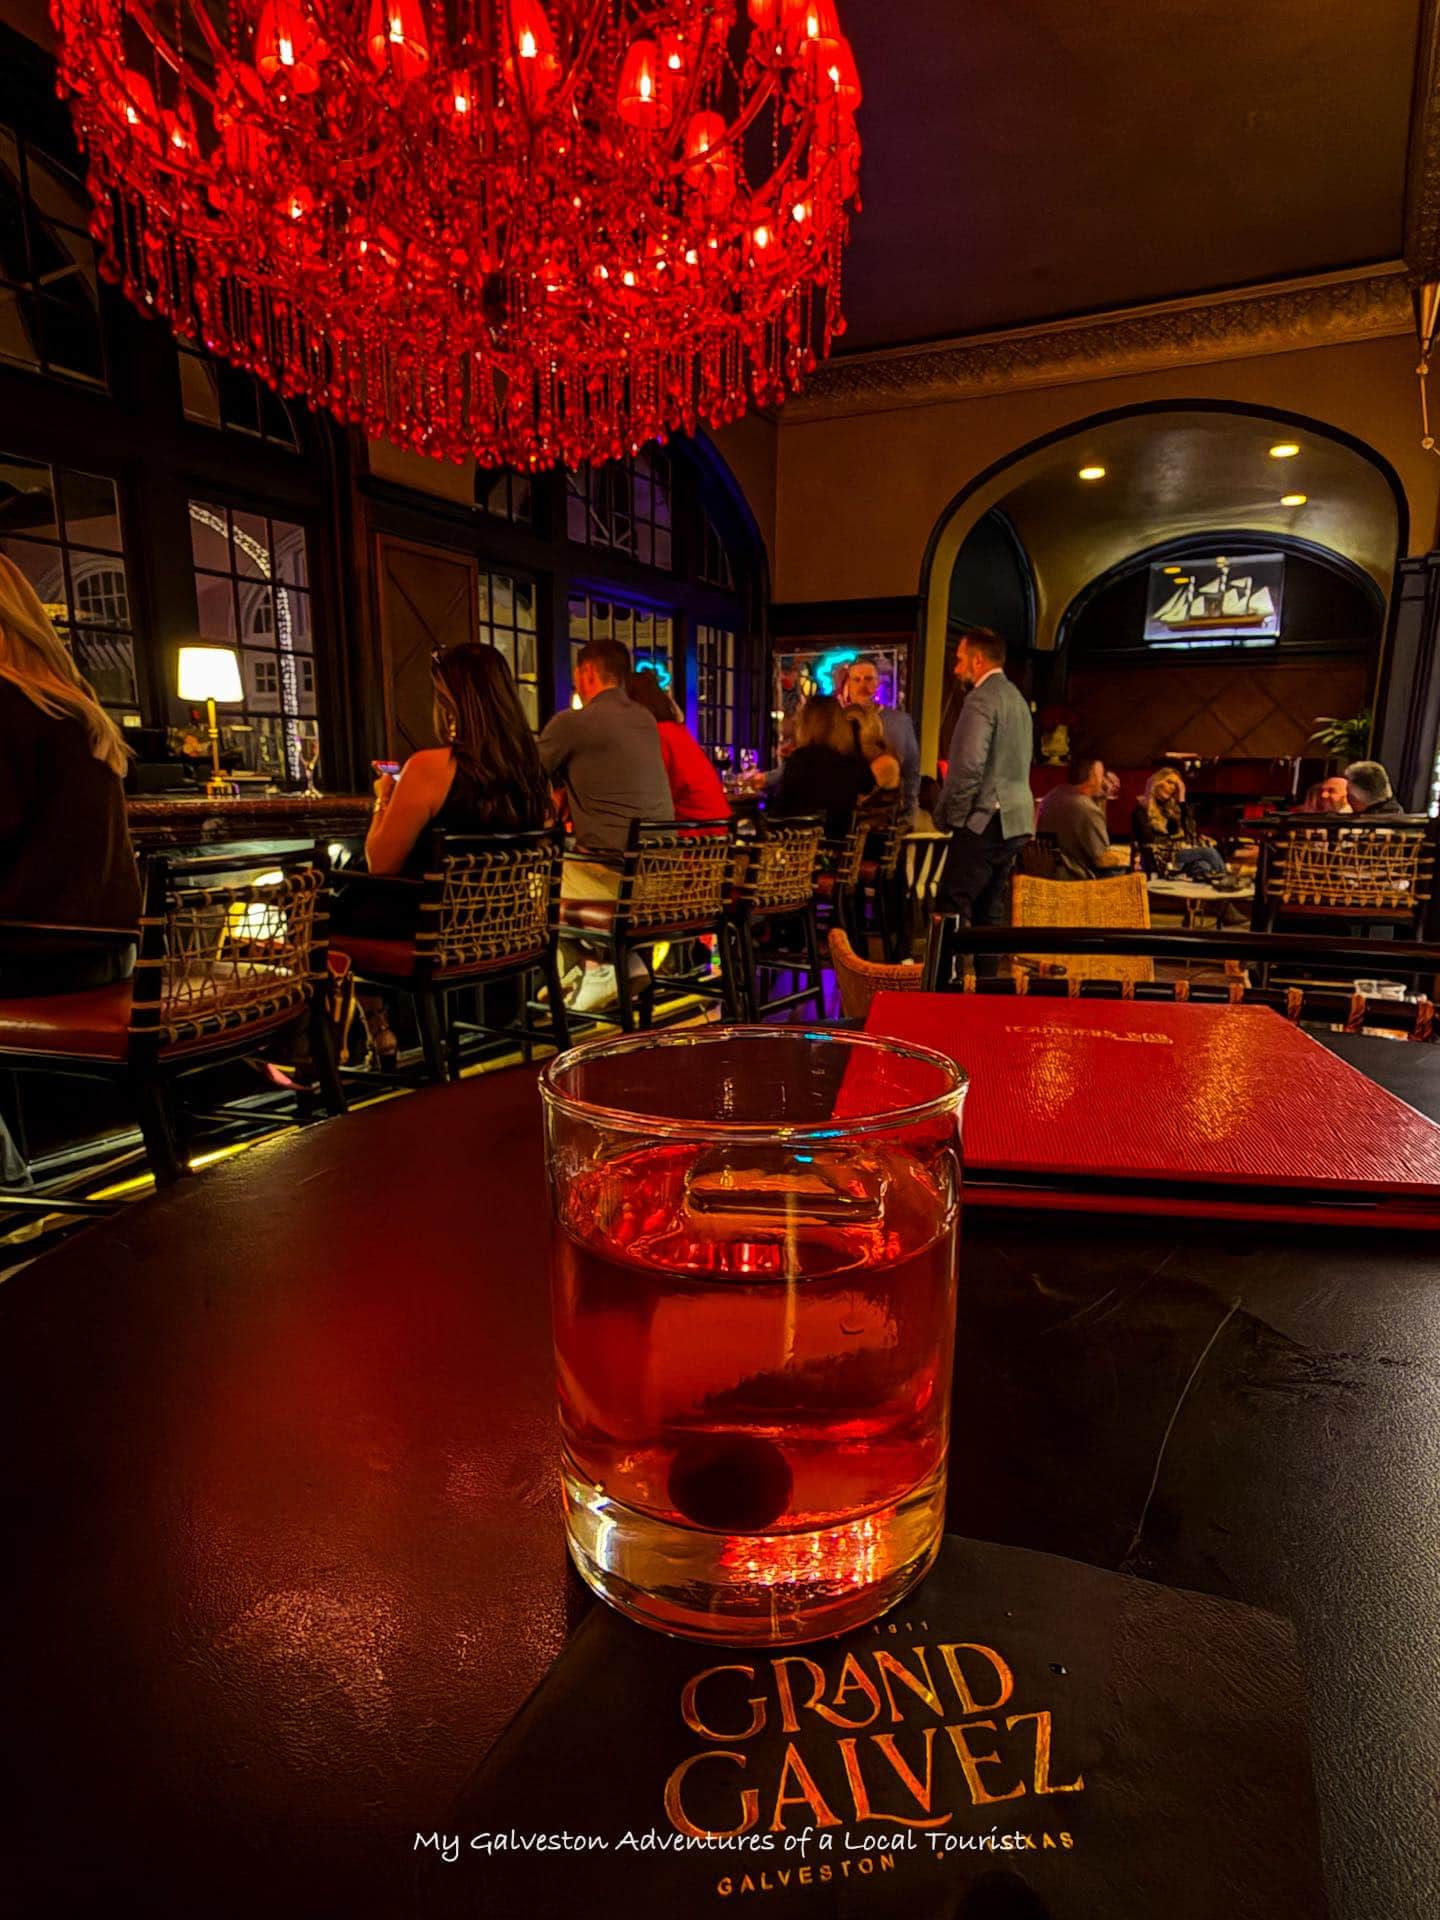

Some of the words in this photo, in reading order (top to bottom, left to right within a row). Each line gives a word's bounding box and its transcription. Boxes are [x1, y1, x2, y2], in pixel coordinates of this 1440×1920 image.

[873, 1620, 929, 1635] 1911
[681, 1643, 1014, 1741] GRAND
[664, 1711, 1085, 1837] GALVEZ
[717, 1853, 896, 1896] GALVESTON
